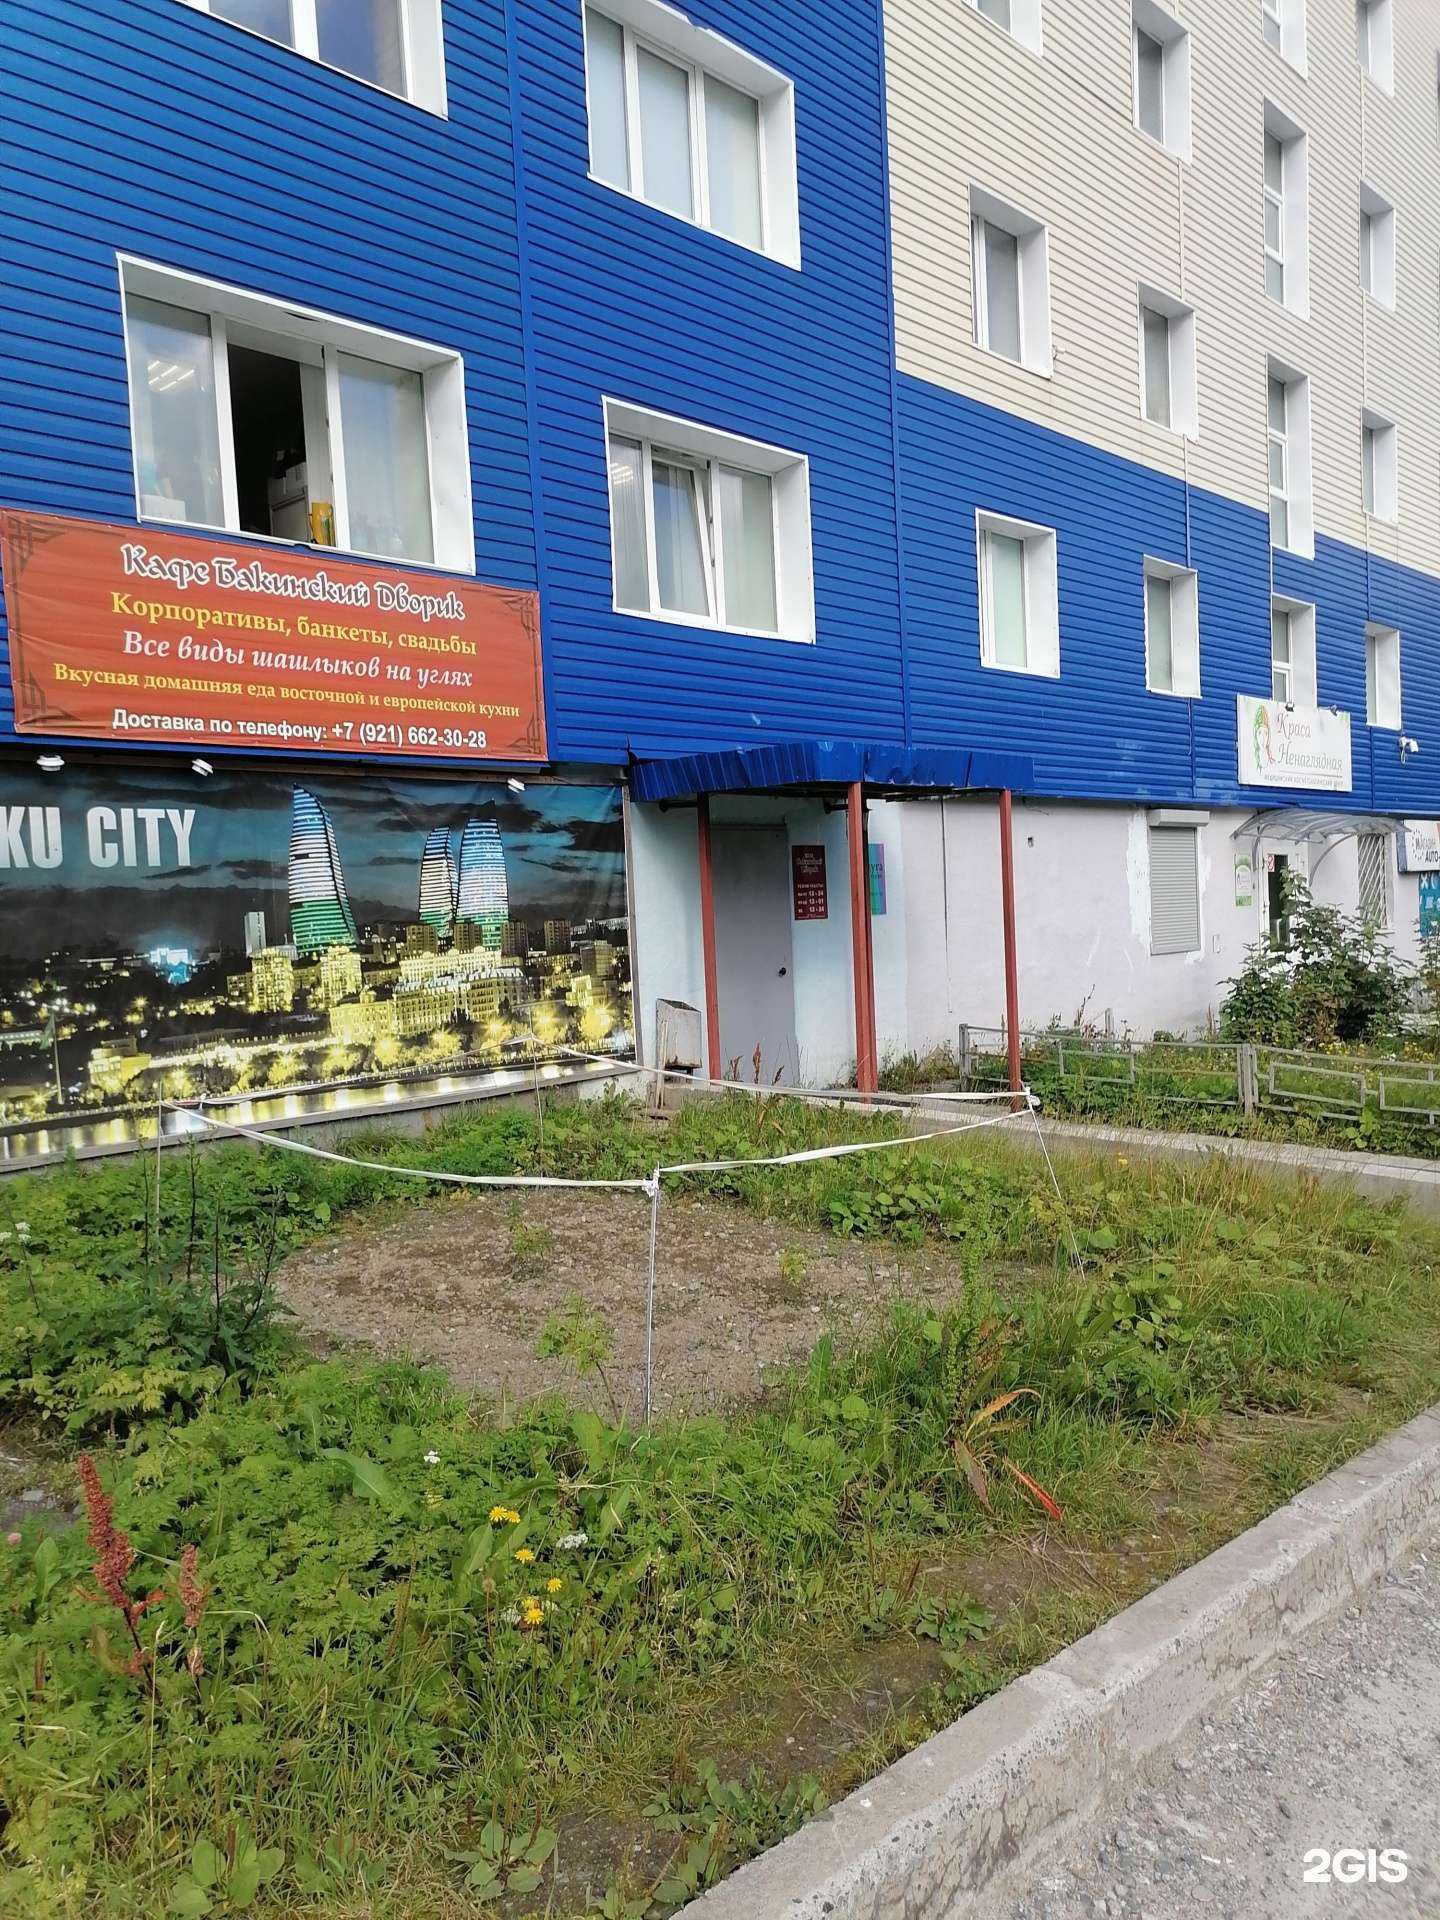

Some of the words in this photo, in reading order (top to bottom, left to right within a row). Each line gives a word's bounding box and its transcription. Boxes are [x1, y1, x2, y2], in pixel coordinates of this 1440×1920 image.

[120, 543, 209, 589] Кафе
[212, 556, 370, 607] Бакинский
[373, 581, 465, 622] Дворик
[110, 591, 292, 637] Корпоративы,
[297, 616, 393, 648] банкеты,
[398, 632, 477, 656] свадьбы
[123, 630, 170, 657] Все
[178, 636, 244, 665] виды
[252, 650, 380, 678] шашлыков
[386, 664, 411, 681] на
[417, 666, 473, 689] углях
[54, 663, 139, 687] Вкусная
[144, 673, 243, 695] домашняя
[247, 684, 276, 699] еда
[280, 687, 365, 705] восточной
[369, 694, 380, 706] и
[383, 695, 476, 714] европейской
[479, 704, 520, 719] кухни
[112, 708, 204, 732] Доставка
[210, 718, 232, 733] по
[236, 720, 327, 743] телефону:
[331, 722, 354, 741] +7
[359, 723, 403, 747] (921)
[407, 725, 487, 748] 662-30-28
[1277, 712, 1311, 740] Краса
[1277, 741, 1343, 771] Ненаглядная
[0, 806, 64, 869] KU
[86, 806, 196, 868] CITY
